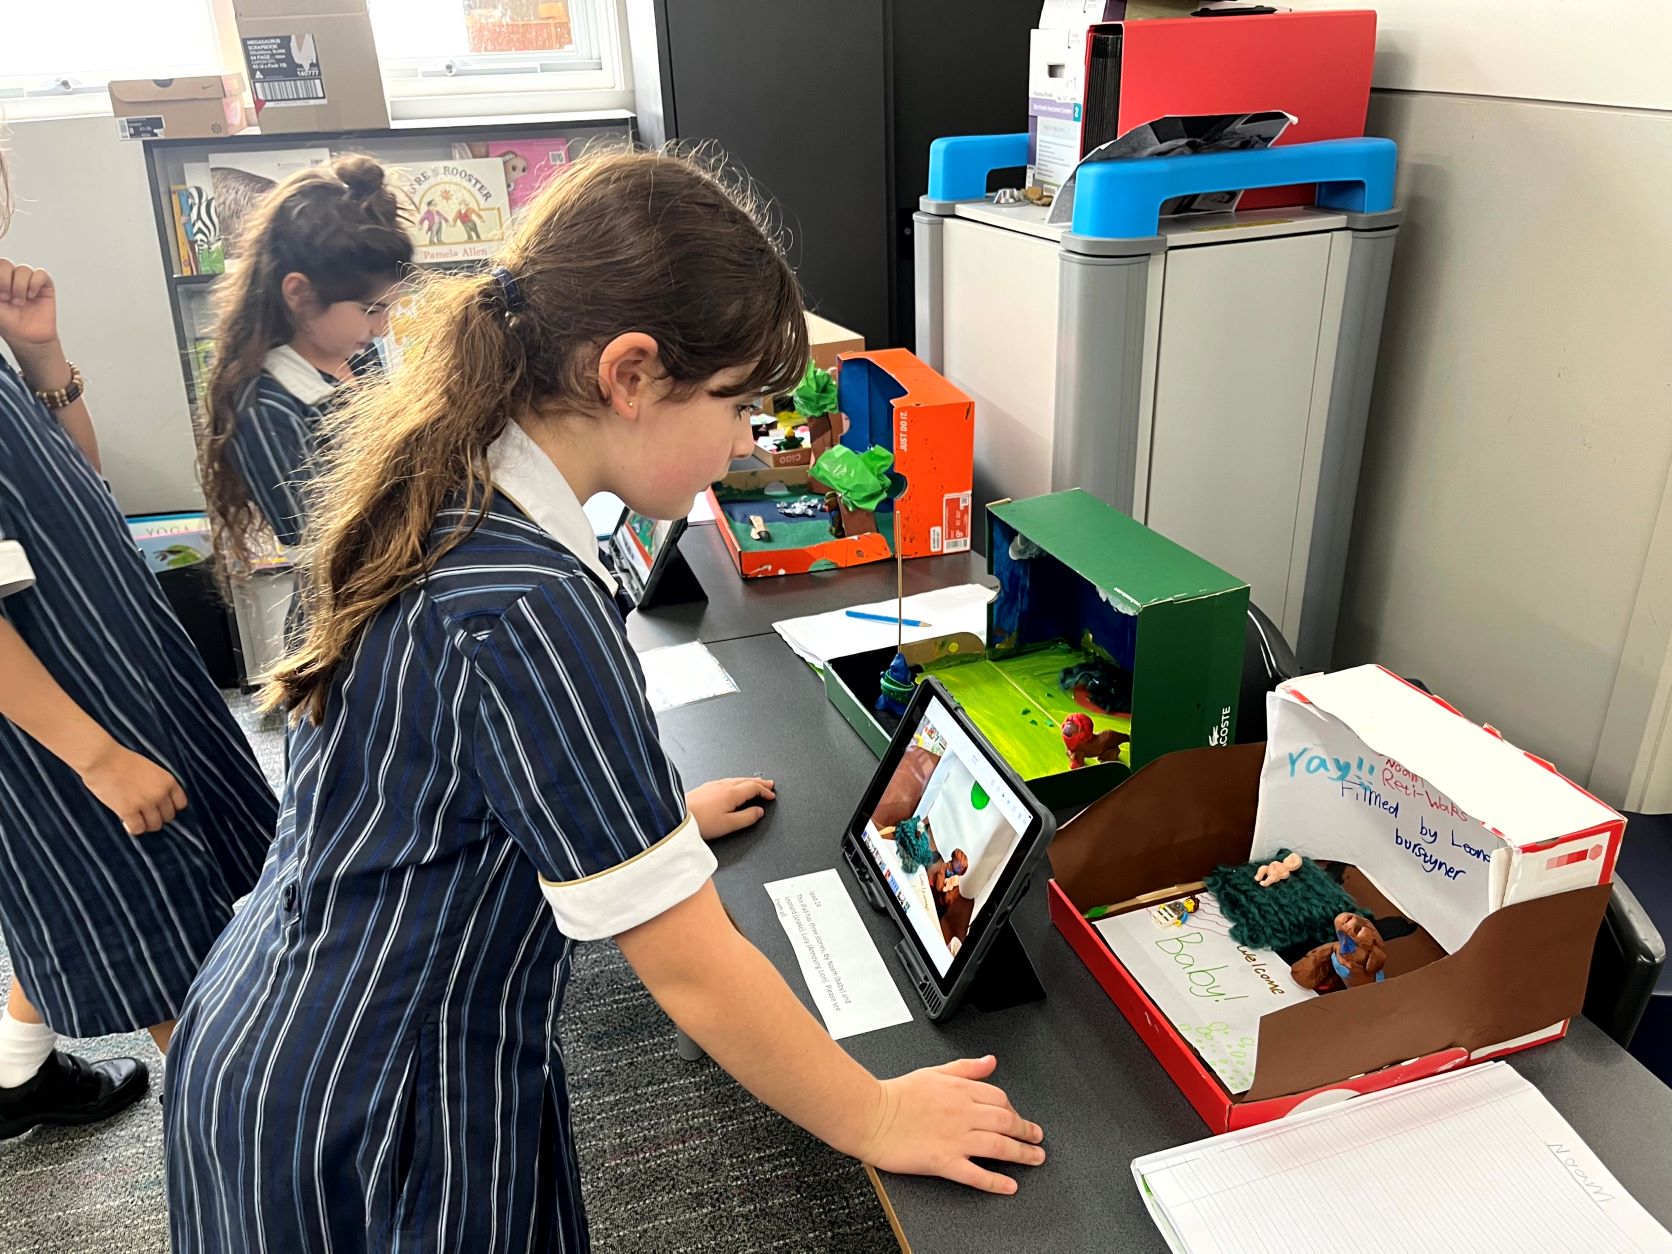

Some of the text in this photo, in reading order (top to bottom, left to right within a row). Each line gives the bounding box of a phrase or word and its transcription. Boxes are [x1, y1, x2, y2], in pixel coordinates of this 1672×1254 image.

[1074, 106, 1079, 118] 2
[442, 165, 493, 203] ROOSTER
[423, 247, 488, 260] Pamela Allen
[899, 421, 908, 432] DO
[899, 432, 908, 453] JUST
[1219, 705, 1231, 747] COSTE
[1341, 779, 1400, 819] Filmed
[1419, 815, 1438, 844] by
[784, 896, 798, 915] Leonard
[824, 984, 837, 1002] Please
[832, 1002, 842, 1012] see
[809, 922, 818, 936] three
[826, 960, 838, 976] Noam
[841, 993, 853, 1004] and
[1155, 931, 1249, 1003] Baby!
